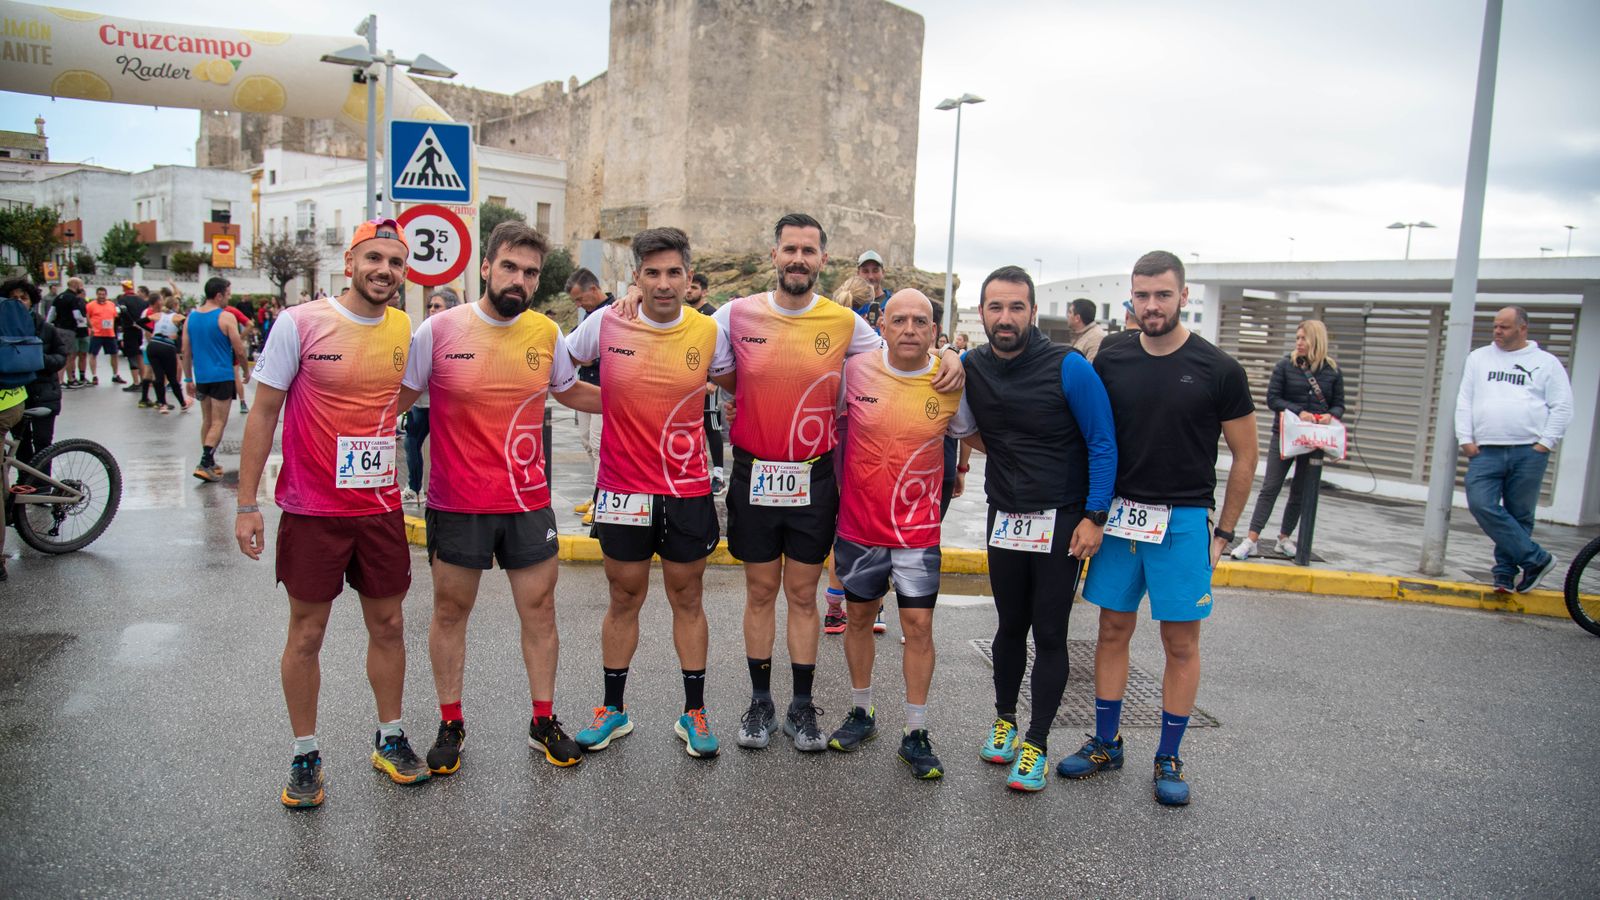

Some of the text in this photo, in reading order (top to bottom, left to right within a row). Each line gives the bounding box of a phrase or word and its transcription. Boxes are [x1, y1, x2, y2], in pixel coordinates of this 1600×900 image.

[0, 16, 52, 42] IMÓN
[99, 23, 252, 59] Cruzcampo
[0, 40, 53, 66] ANTE
[116, 55, 193, 81] Radler
[1488, 371, 1525, 386] PUMA
[350, 441, 370, 450] XIV
[361, 451, 381, 471] 64
[762, 465, 780, 473] XIV
[766, 474, 796, 491] 110
[612, 493, 631, 509] 57
[1127, 508, 1148, 527] 58
[1013, 520, 1032, 536] 81
